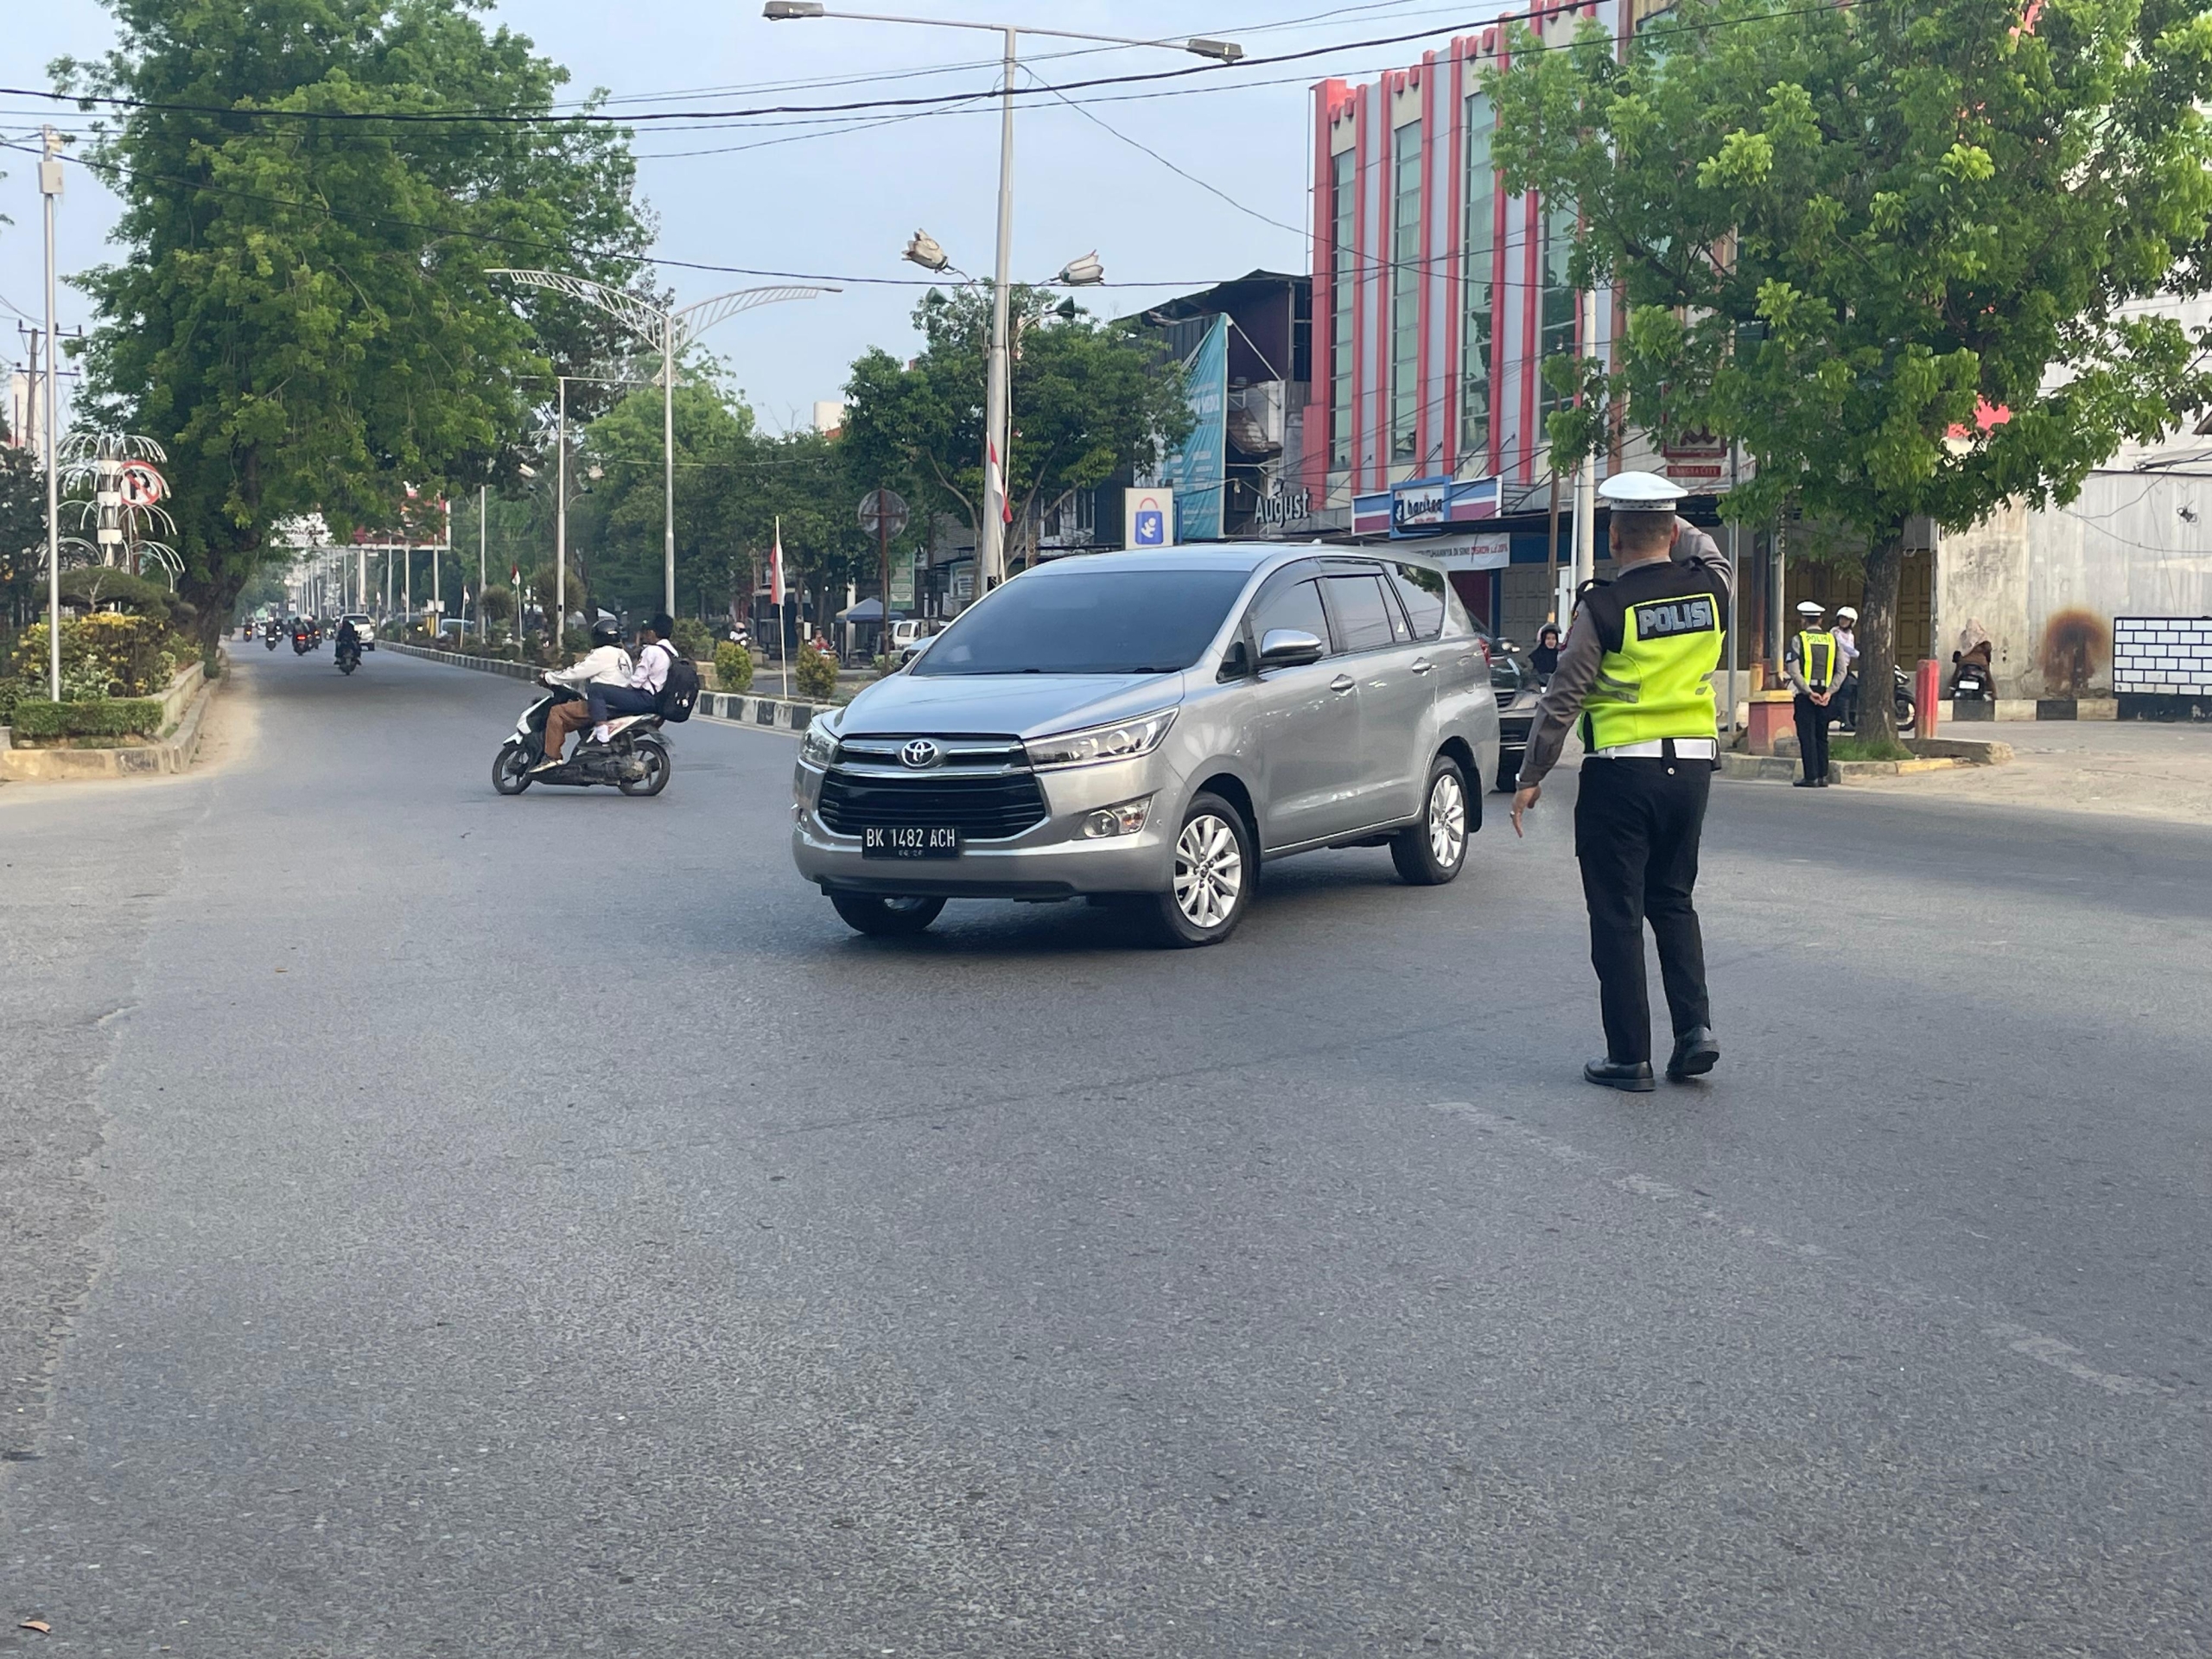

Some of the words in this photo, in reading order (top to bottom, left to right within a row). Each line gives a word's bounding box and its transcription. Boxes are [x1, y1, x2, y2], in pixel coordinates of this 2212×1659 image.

[1255, 487, 1308, 528] August
[1638, 601, 1713, 635] POLISI
[1806, 634, 1831, 643] POLISI
[867, 829, 884, 847] BK
[893, 829, 924, 847] 1482
[930, 829, 955, 847] ACH
